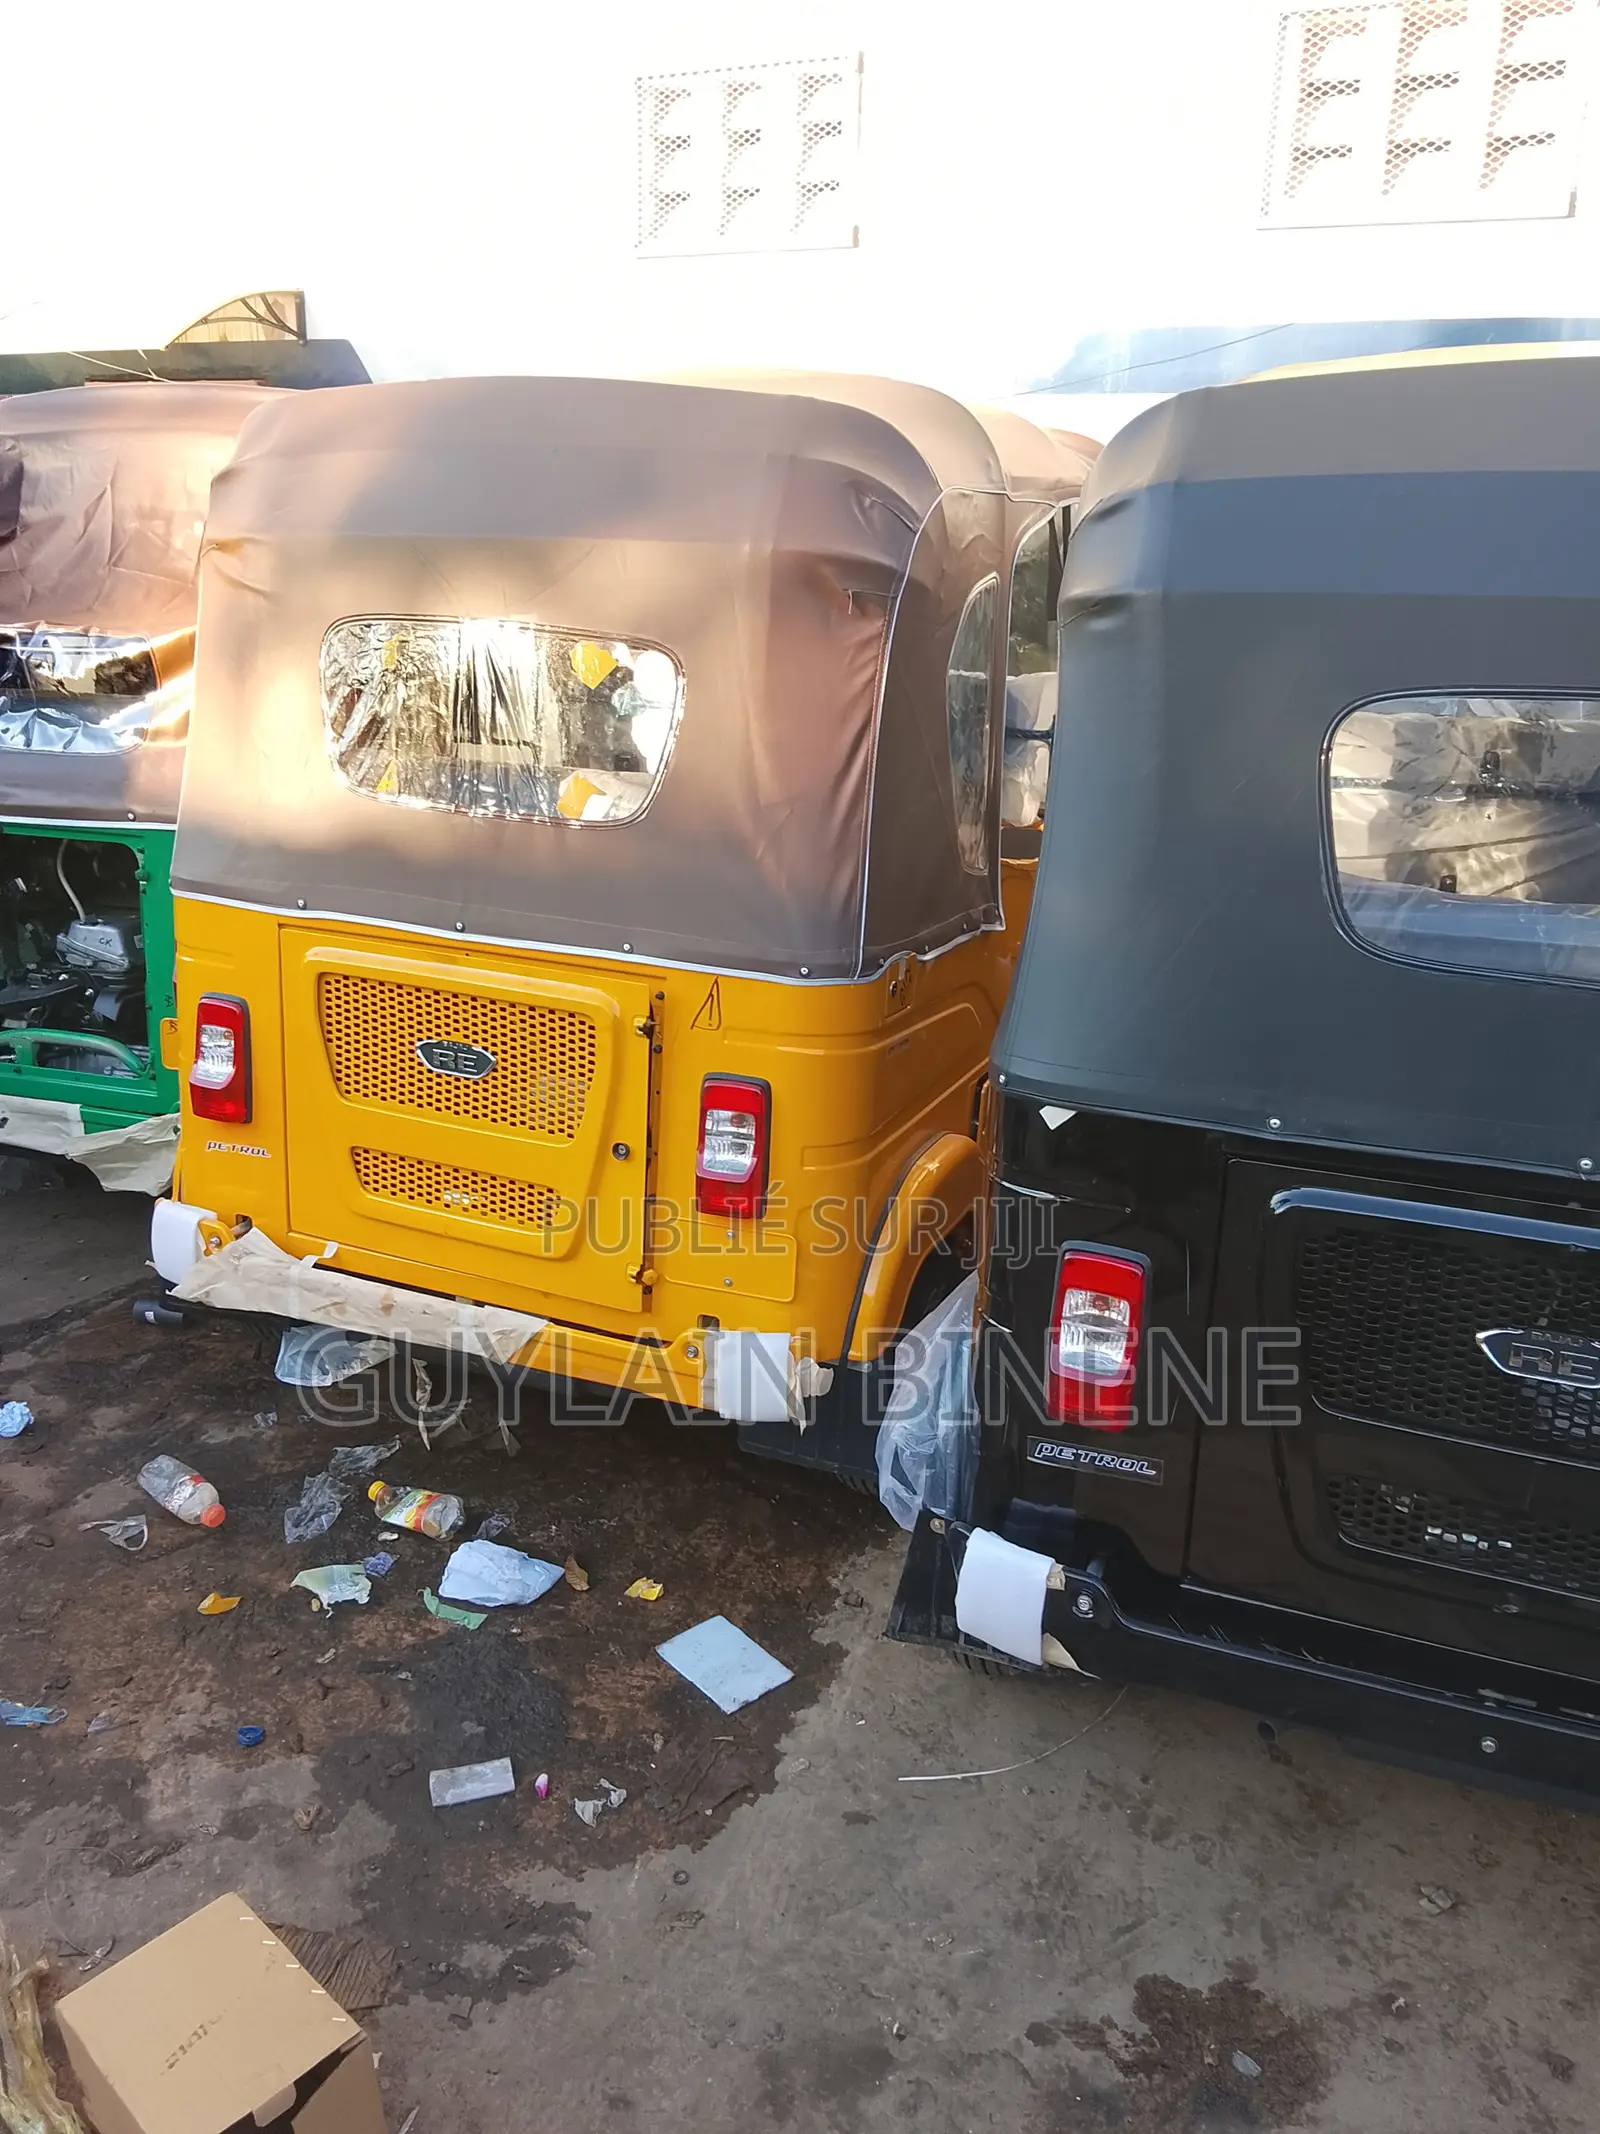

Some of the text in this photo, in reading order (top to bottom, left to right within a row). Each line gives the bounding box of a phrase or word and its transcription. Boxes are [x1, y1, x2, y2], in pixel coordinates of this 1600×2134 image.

[432, 1048, 478, 1073] RE
[206, 1140, 272, 1158] PETROL
[1508, 1342, 1599, 1380] RE
[1034, 1442, 1157, 1476] PETROL
